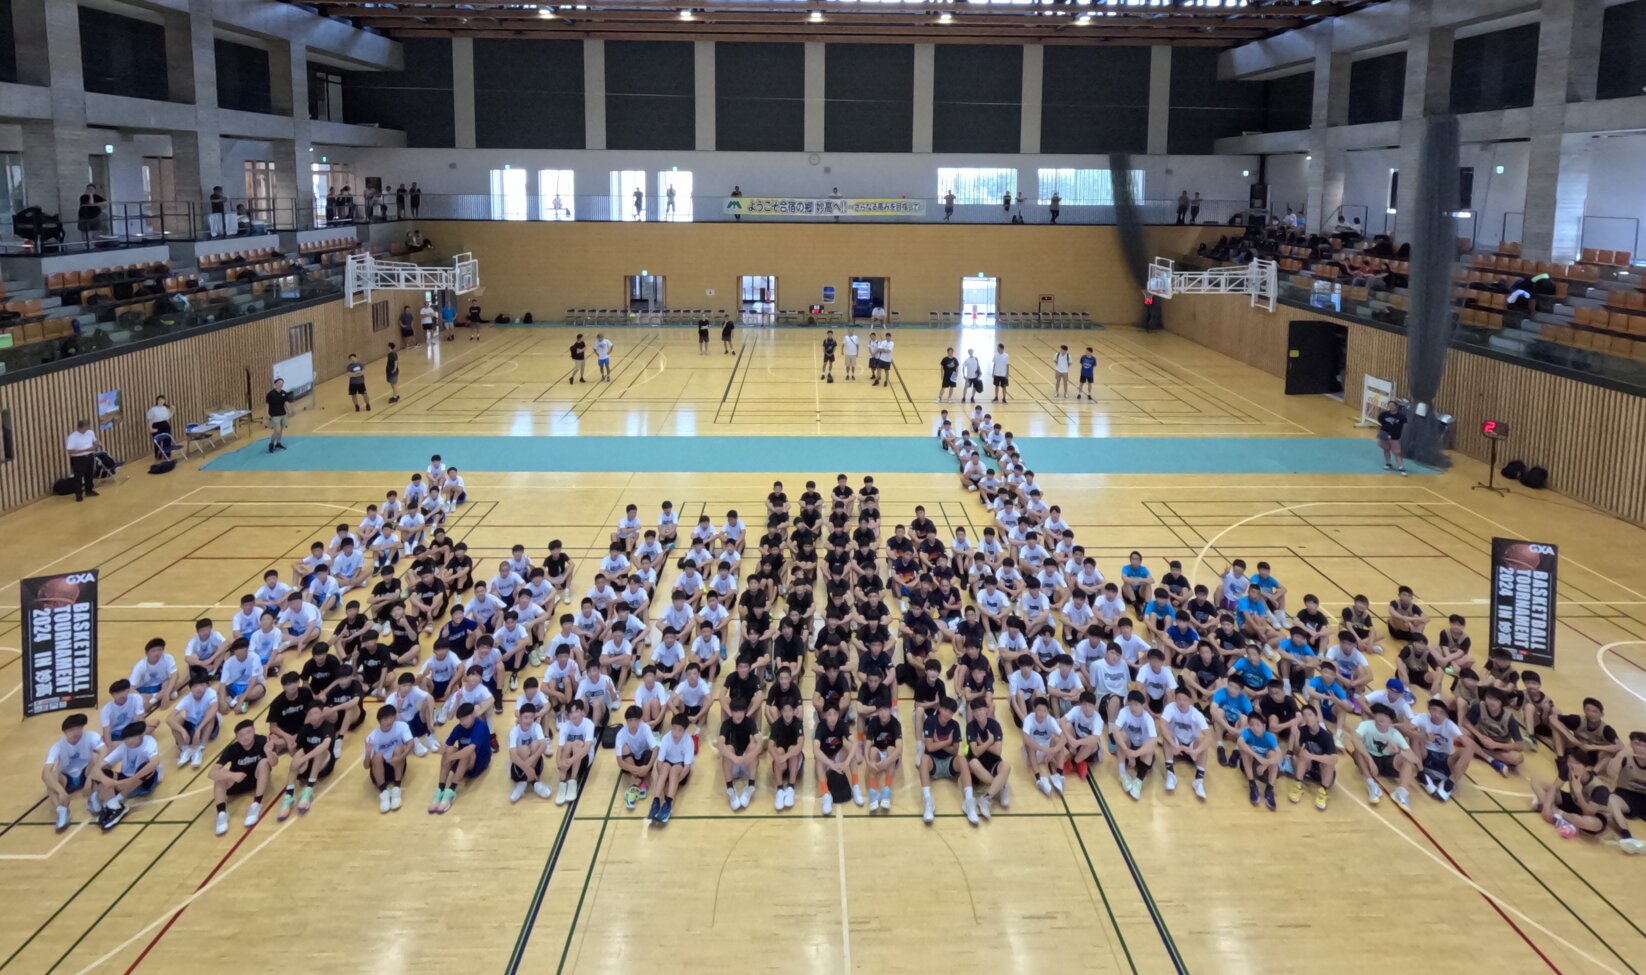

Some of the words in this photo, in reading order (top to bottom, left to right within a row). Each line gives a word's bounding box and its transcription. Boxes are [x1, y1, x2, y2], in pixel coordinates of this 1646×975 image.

[1484, 421, 1496, 433] 2
[1498, 566, 1514, 597] 2024
[32, 607, 52, 643] 2024
[1497, 605, 1513, 619] IN
[1513, 569, 1531, 649] TOURNAMENT
[1530, 570, 1549, 649] BASKETBALL
[34, 651, 53, 668] IN
[54, 604, 73, 694] TOURNAMENT
[73, 602, 90, 693] BASKETBALL
